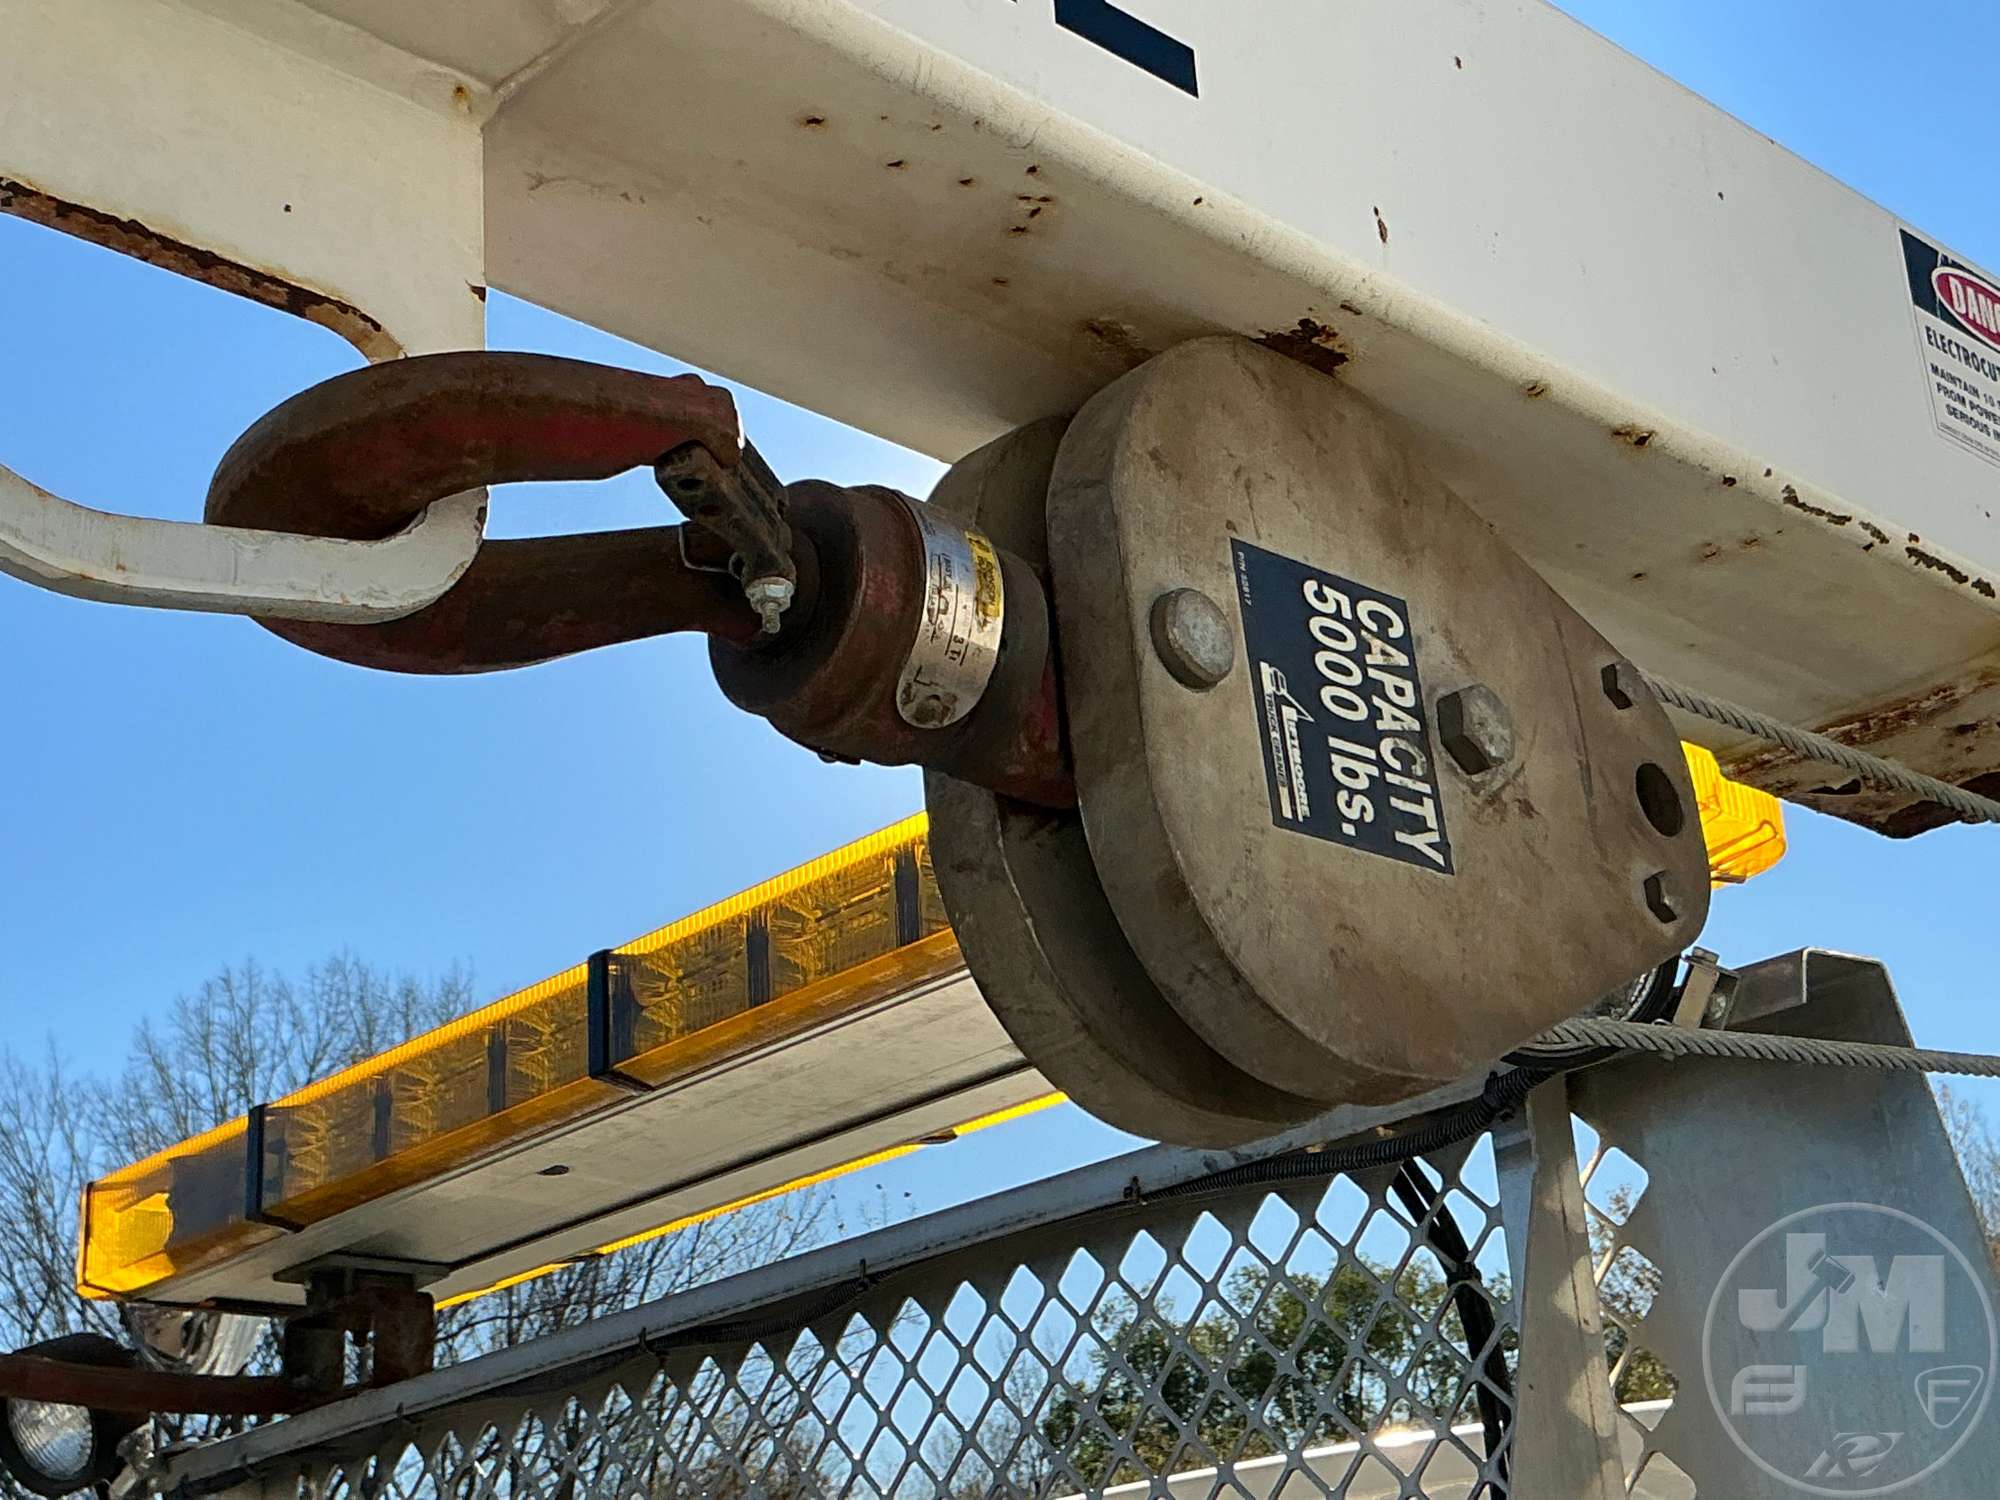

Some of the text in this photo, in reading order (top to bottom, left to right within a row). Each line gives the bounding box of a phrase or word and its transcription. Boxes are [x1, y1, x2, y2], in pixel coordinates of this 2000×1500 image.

[1931, 363, 1980, 400] MAINTAIN
[1936, 382, 1967, 408] FROM
[1945, 404, 1991, 437] SERIOUS
[1265, 693, 1279, 734] TRUCK
[1303, 579, 1380, 837] 5000 lbs.
[1356, 599, 1446, 867] CAPACITY
[1282, 705, 1310, 818] LIFTMOORE
